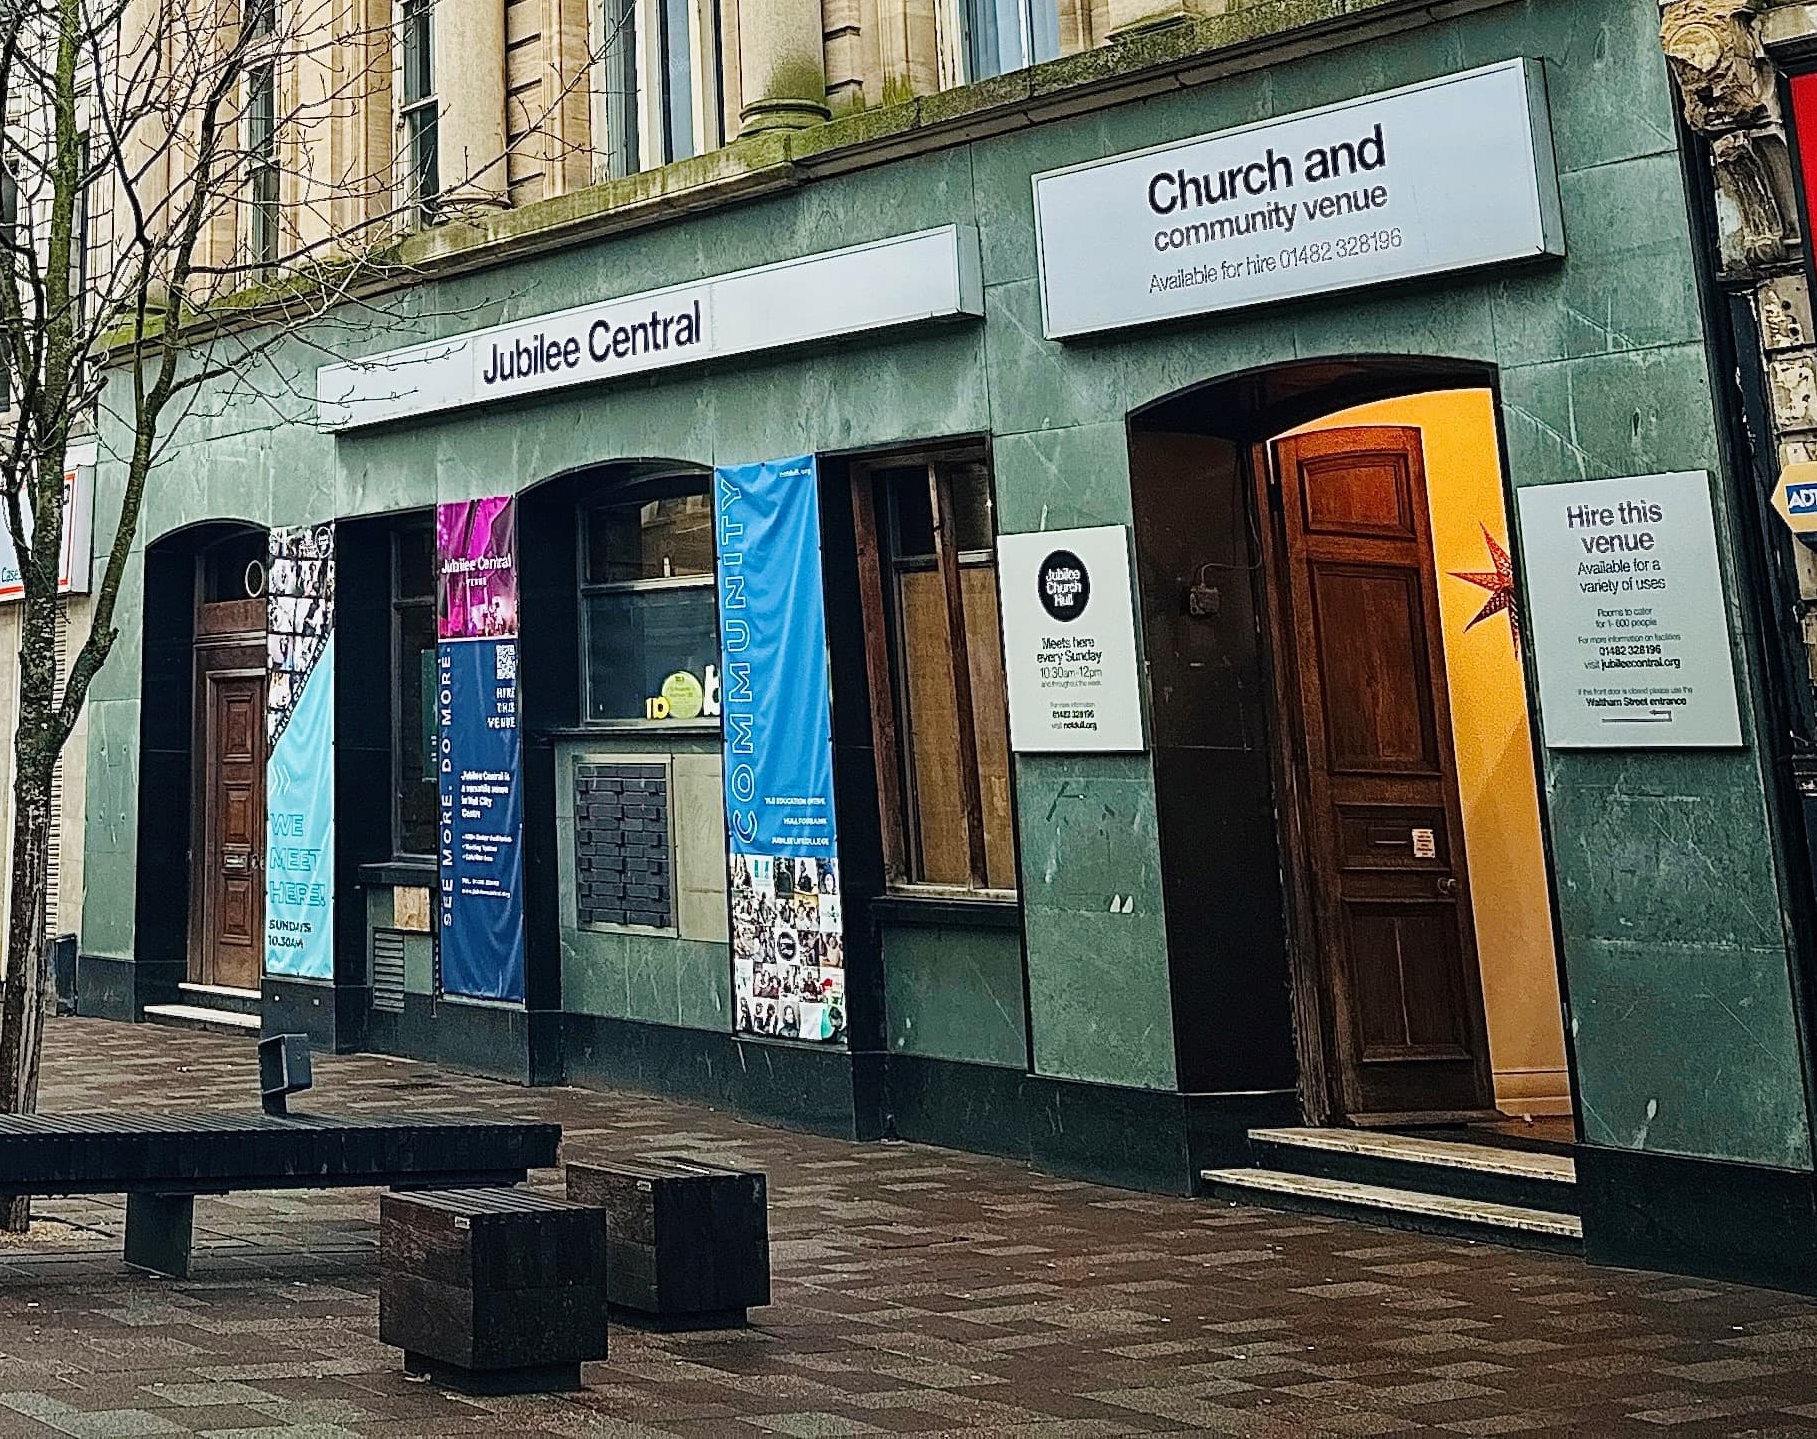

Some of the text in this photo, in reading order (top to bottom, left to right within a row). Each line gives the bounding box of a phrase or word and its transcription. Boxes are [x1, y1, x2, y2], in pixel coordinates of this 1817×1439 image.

[1148, 123, 1386, 215] Church and
[1154, 185, 1388, 252] community venue
[1149, 227, 1402, 293] Available for hire 01482 328196
[483, 300, 701, 384] Jubilee Central
[1566, 499, 1663, 529] Hire this
[1580, 532, 1655, 554] venue
[442, 553, 512, 573] Jubilee Central
[1577, 558, 1662, 576] Available for a
[1046, 567, 1082, 582] Jubilee
[1047, 580, 1082, 595] Church
[1579, 576, 1666, 595] variety of uses
[1054, 593, 1074, 607] Hull
[1597, 607, 1652, 617] Rooms to cater
[1595, 619, 1605, 628] for
[1631, 618, 1658, 628] people
[1041, 636, 1095, 649] Meets here
[1607, 633, 1644, 642] information
[1037, 649, 1102, 665] every Sunday
[1598, 644, 1662, 656] 01482 328196
[720, 478, 758, 844] COMMUNITY
[1600, 657, 1681, 671] jubileecentral.org
[1586, 697, 1687, 707] Waltham Street entrance
[441, 738, 452, 772] DO
[270, 813, 303, 837] WE
[270, 847, 321, 871] MEET
[441, 879, 453, 927] SEE
